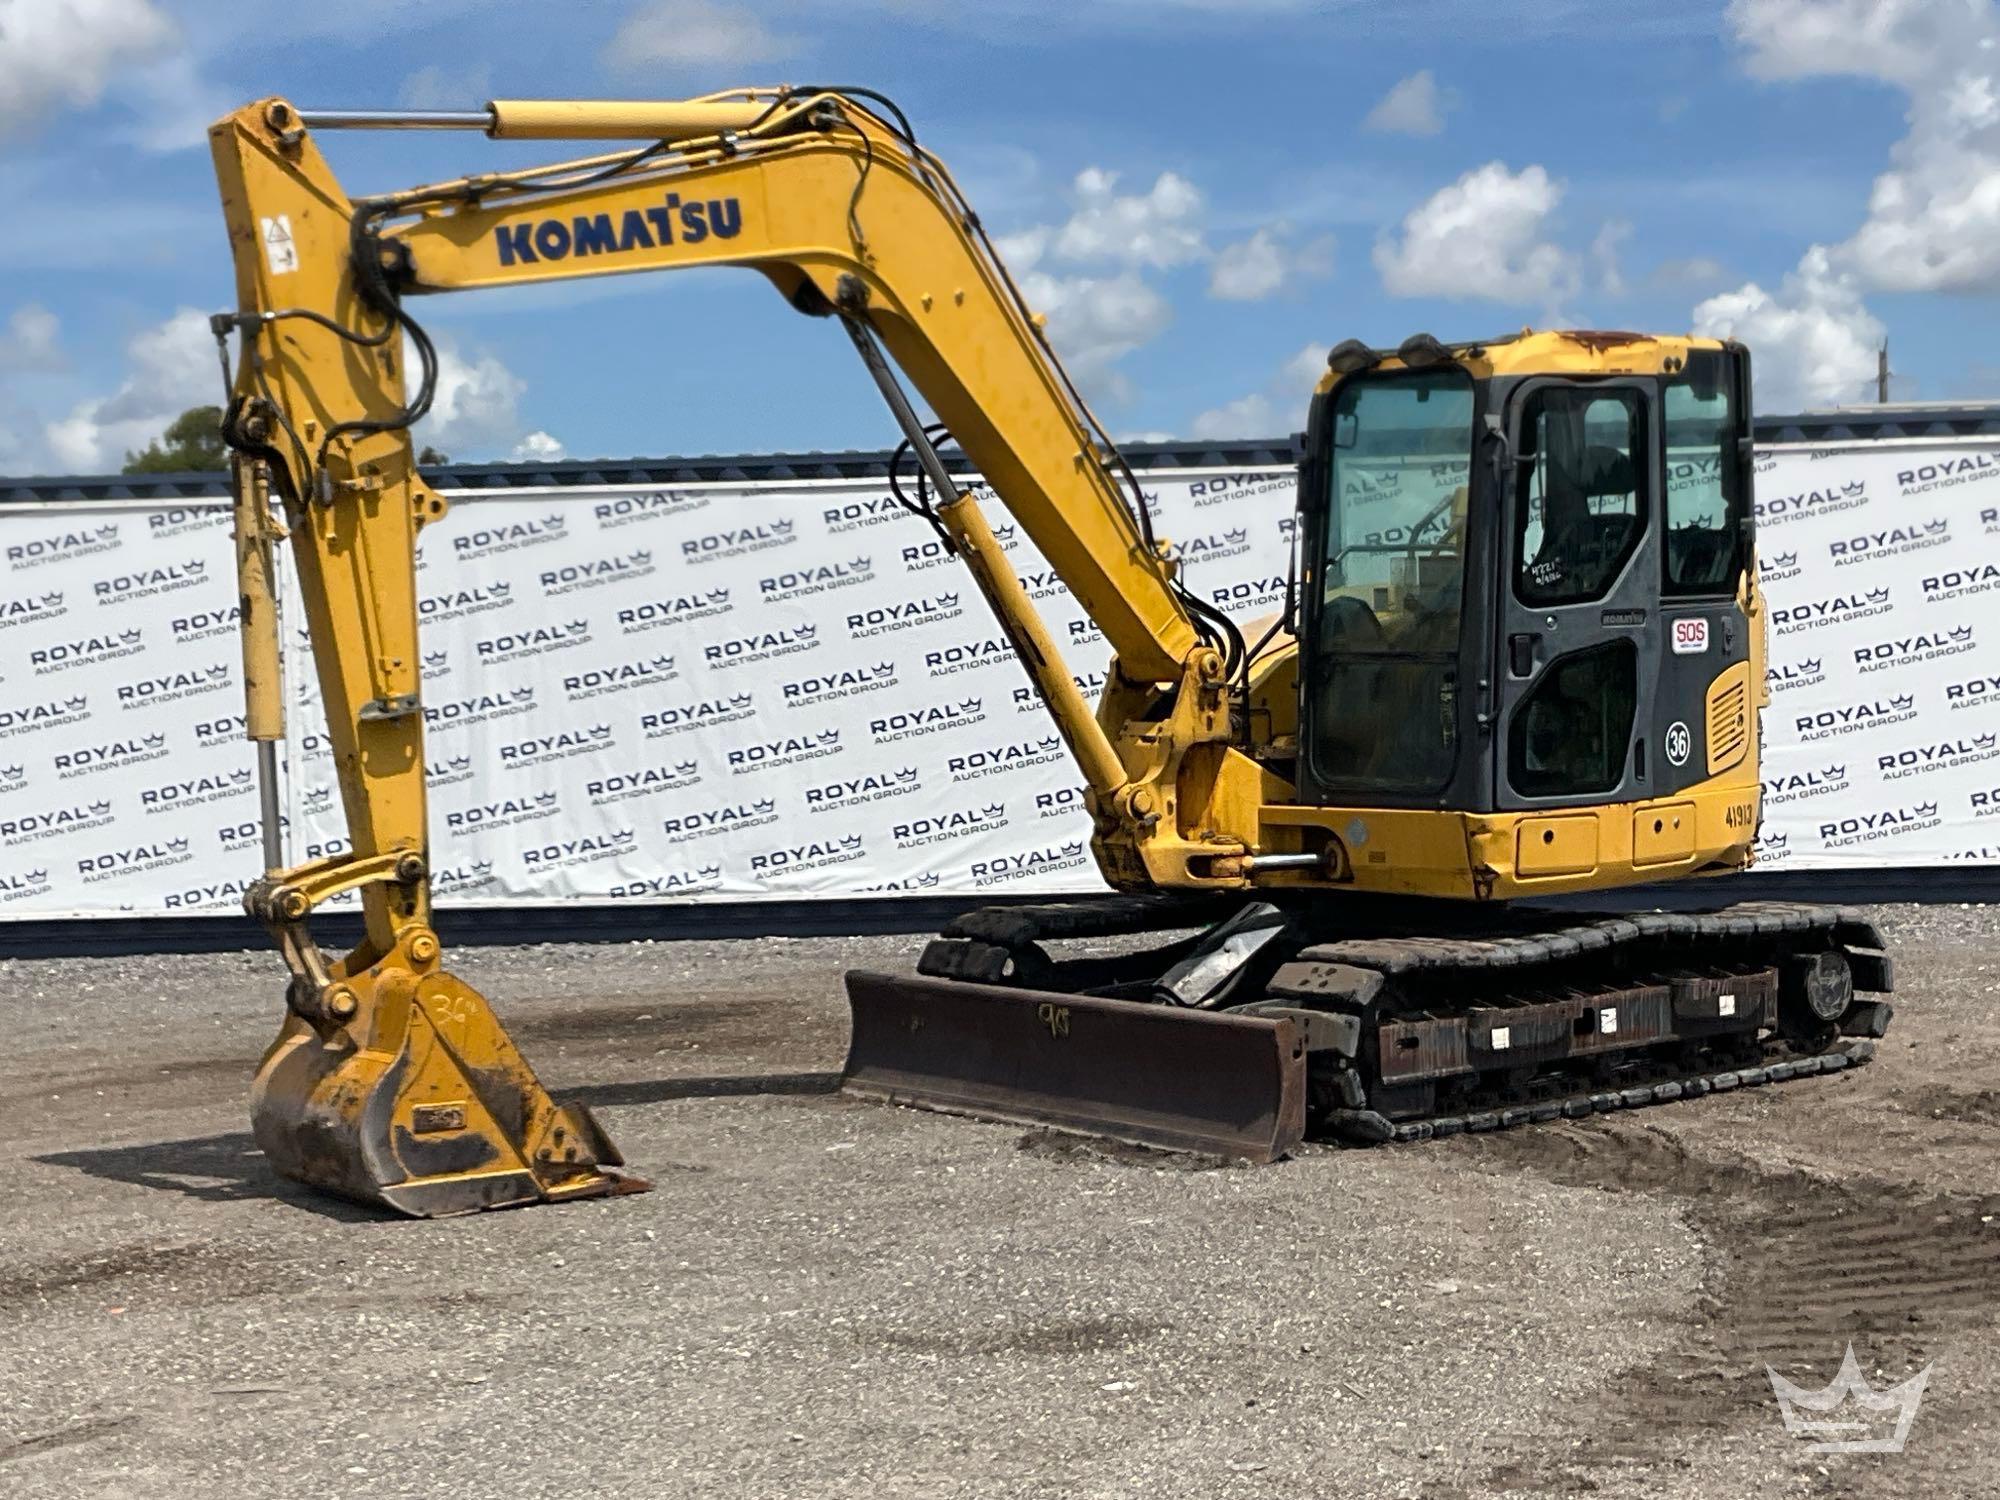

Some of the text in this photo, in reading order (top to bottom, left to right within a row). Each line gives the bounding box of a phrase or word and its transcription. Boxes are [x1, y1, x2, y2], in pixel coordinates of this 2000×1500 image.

[495, 193, 741, 266] KOMATSU
[1897, 455, 1992, 485] ROYAL
[1194, 480, 1299, 507] AUCTION GROU
[1902, 476, 1966, 495] AUCTION
[824, 497, 898, 524] ROYA
[1818, 498, 1869, 515] GROUP
[454, 521, 542, 551] ROYAL
[829, 514, 889, 533] AUCTION
[7, 531, 96, 561] ROYAL
[12, 539, 122, 570] AUCTION GROUP
[458, 530, 568, 561] AUCTION GROUP
[681, 526, 771, 556] ROYAL
[686, 535, 797, 565] AUCTION GROUP
[1201, 545, 1250, 562] GROUP
[1829, 526, 1924, 557] ROYAL
[1834, 535, 1952, 567] AUCTION GROUP
[94, 566, 183, 596] ROYAL
[540, 557, 629, 587] ROYAL
[545, 566, 655, 596] AUCTION GROUP
[760, 563, 849, 593] ROYAL
[1922, 565, 2000, 593] ROYA
[99, 575, 209, 606] AUCTION GROUP
[419, 589, 488, 614] OYAL
[764, 572, 875, 603] AUCTION GROUP
[1213, 576, 1288, 604] ROYA
[1927, 583, 1991, 603] AUCTION
[19, 607, 68, 624] GROUP
[618, 595, 707, 625] ROYAL
[623, 604, 733, 634] AUCTION GROUP
[847, 599, 937, 629] ROYAL
[852, 608, 963, 639] AUCTION GROUP
[1772, 595, 1866, 625] ROYAL
[1777, 604, 1893, 635] AUCTION GROUP
[177, 624, 237, 643] AUCTION
[477, 626, 566, 656] ROYAL
[705, 631, 794, 661] ROYAL
[1677, 622, 1704, 642] SOS
[30, 635, 119, 665] ROYAL
[35, 644, 145, 675] AUCTION GROUP
[482, 635, 592, 666] AUCTION GROUP
[709, 640, 820, 670] AUCTION GROUP
[925, 637, 1012, 668] ROYAL
[1854, 633, 1949, 664] ROYAL
[1859, 642, 1976, 673] AUCTION GROUP
[563, 662, 653, 692] ROYAL
[930, 658, 990, 677] AUCTION
[117, 671, 206, 701] ROYAL
[122, 680, 232, 710] AUCTION GROUP
[568, 671, 678, 701] AUCTION GROUP
[783, 669, 872, 699] ROYAL
[787, 678, 898, 708] AUCTION GROUP
[1775, 675, 1826, 692] GROUP
[0, 703, 65, 728] OYAL
[43, 711, 90, 729] GROUP
[423, 693, 512, 723] ROYAL
[428, 702, 538, 732] AUCTION GROUP
[641, 700, 730, 730] ROYAL
[870, 705, 960, 735] ROYAL
[1796, 701, 1890, 732] ROYAL
[646, 709, 756, 739] AUCTION GROUP
[875, 714, 986, 744] AUCTION GROUP
[1801, 710, 1918, 742] AUCTION GROUP
[54, 740, 143, 770] ROYAL
[500, 731, 589, 761] ROYAL
[505, 740, 615, 770] AUCTION GROUP
[728, 736, 817, 766] ROYAL
[948, 743, 1038, 772] ROYAL
[1670, 731, 1686, 757] 36
[1878, 740, 1973, 771] ROYAL
[59, 749, 169, 779] AUCTION GROUP
[732, 745, 843, 775] AUCTION GROUP
[953, 752, 1064, 782] AUCTION GROUP
[1883, 749, 2000, 780] AUCTION GROUP
[141, 775, 229, 805] ROYAL
[587, 767, 676, 796] ROYAL
[591, 776, 702, 806] AUCTION GROUP
[806, 774, 895, 804] ROYAL
[1799, 781, 1851, 798] GROUP
[146, 784, 255, 815] AUCTION GROUP
[446, 798, 535, 827] ROYAL
[810, 783, 921, 814] AUCTION GROUP
[0, 807, 89, 837] ROYAL
[5, 815, 115, 846] AUCTION GROUP
[451, 807, 560, 837] AUCTION GROUP
[664, 805, 753, 834] ROYAL
[669, 814, 779, 844] AUCTION GROUP
[893, 810, 983, 840] ROYAL
[1725, 804, 1752, 828] 41913
[1819, 809, 1914, 839] ROYAL
[897, 819, 1009, 849] AUCTION GROUP
[1824, 818, 1942, 849] AUCTION GROUP
[78, 844, 167, 874] ROYAL
[523, 836, 612, 865] ROYAL
[528, 844, 638, 875] AUCTION GROUP
[750, 841, 840, 870] ROYAL
[755, 850, 866, 880] AUCTION GROUP
[971, 848, 1061, 877] ROYAL
[83, 853, 193, 884] AUCTION GROUP
[976, 857, 1086, 886] AUCTION GROUP
[3, 884, 52, 902] GROUP
